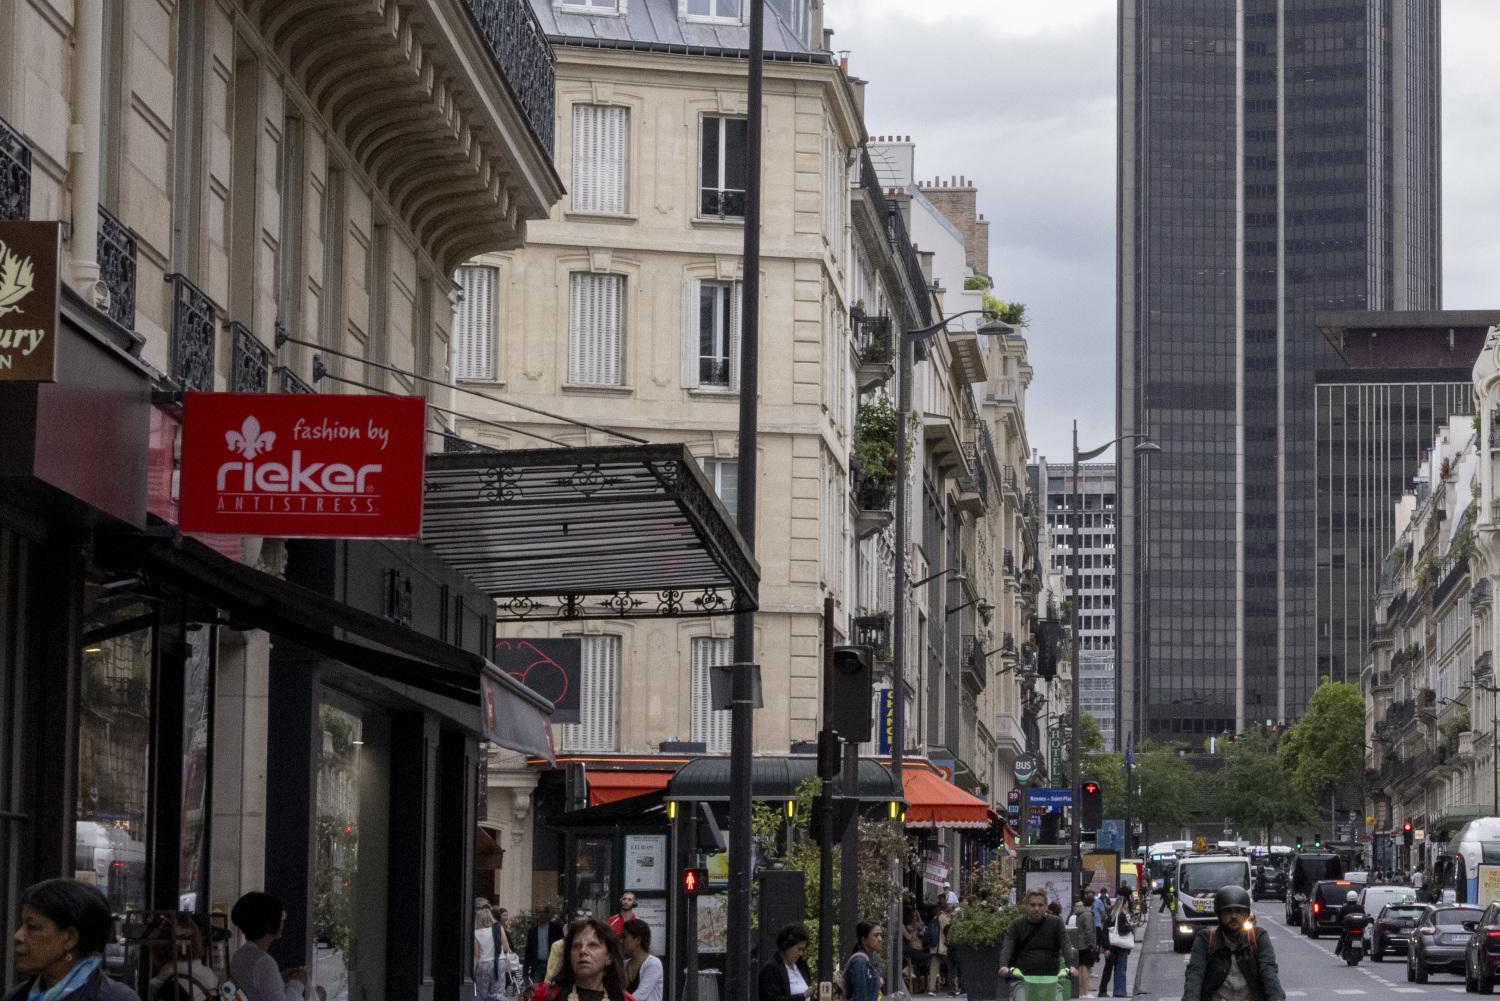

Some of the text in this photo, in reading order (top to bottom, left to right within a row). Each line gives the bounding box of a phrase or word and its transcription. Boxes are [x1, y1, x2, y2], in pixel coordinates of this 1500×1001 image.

[293, 417, 390, 450] fashion by
[216, 449, 383, 493] rieker
[217, 496, 374, 513] ANTISTRESS
[1015, 761, 1031, 770] BUS
[1051, 730, 1061, 776] HOTEL
